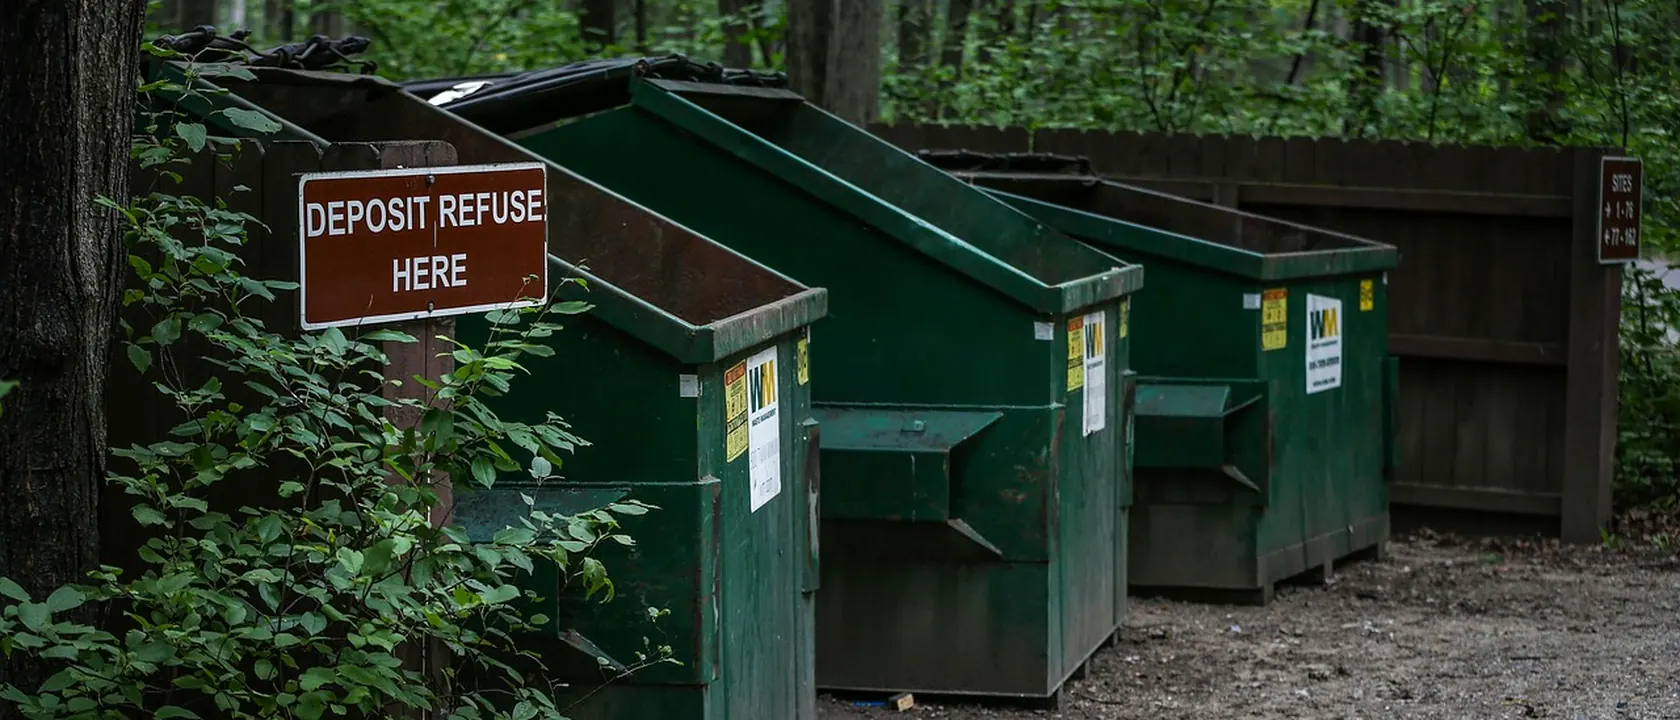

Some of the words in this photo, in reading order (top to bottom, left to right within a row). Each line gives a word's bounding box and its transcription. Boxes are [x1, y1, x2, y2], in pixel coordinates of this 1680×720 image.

[1612, 174, 1632, 193] SITES
[306, 196, 430, 237] DEPOSIT
[439, 189, 543, 228] REFUSE
[393, 253, 467, 292] HERE
[1085, 322, 1103, 359] WM
[1310, 307, 1338, 340] WM
[749, 359, 776, 414] WM
